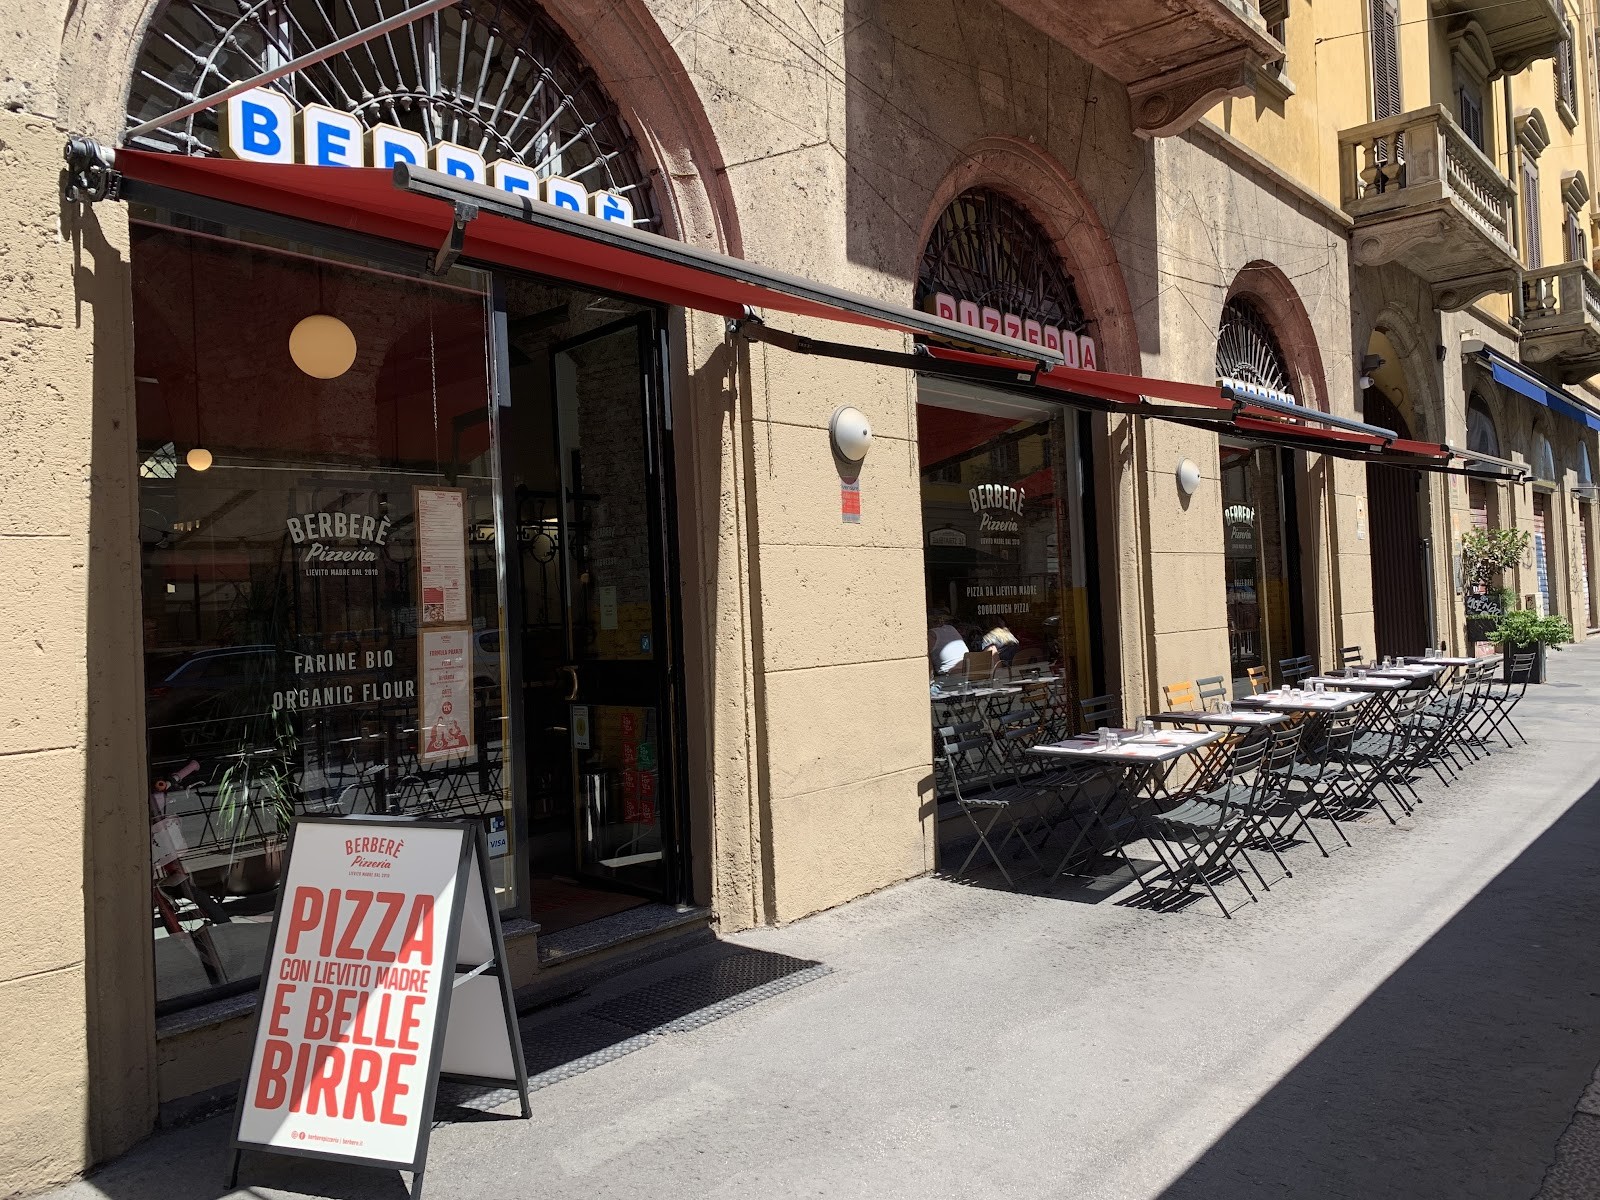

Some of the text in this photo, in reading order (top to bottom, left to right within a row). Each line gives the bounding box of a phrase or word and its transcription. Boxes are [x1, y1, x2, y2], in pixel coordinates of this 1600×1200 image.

[968, 483, 1026, 516] BERBERÈ
[286, 511, 392, 546] BERBERÈ
[979, 512, 1019, 532] Pizzeria
[304, 542, 378, 563] Pizzeria
[966, 585, 1037, 597] PIZZA DA LIEVITO MADRE
[978, 602, 1030, 615] SOURDOUGH PIZZA
[294, 650, 394, 674] FARINE BIO
[272, 680, 415, 710] ORGANIC FLOUR
[345, 836, 405, 859] BERBERÈ
[490, 839, 506, 848] VISA
[351, 855, 391, 869] Pizzeria
[285, 886, 435, 966] PIZZA
[279, 958, 431, 994] CON LIEVITO MADRE
[269, 984, 426, 1051] E BELLE
[254, 1039, 417, 1127] BIRRE
